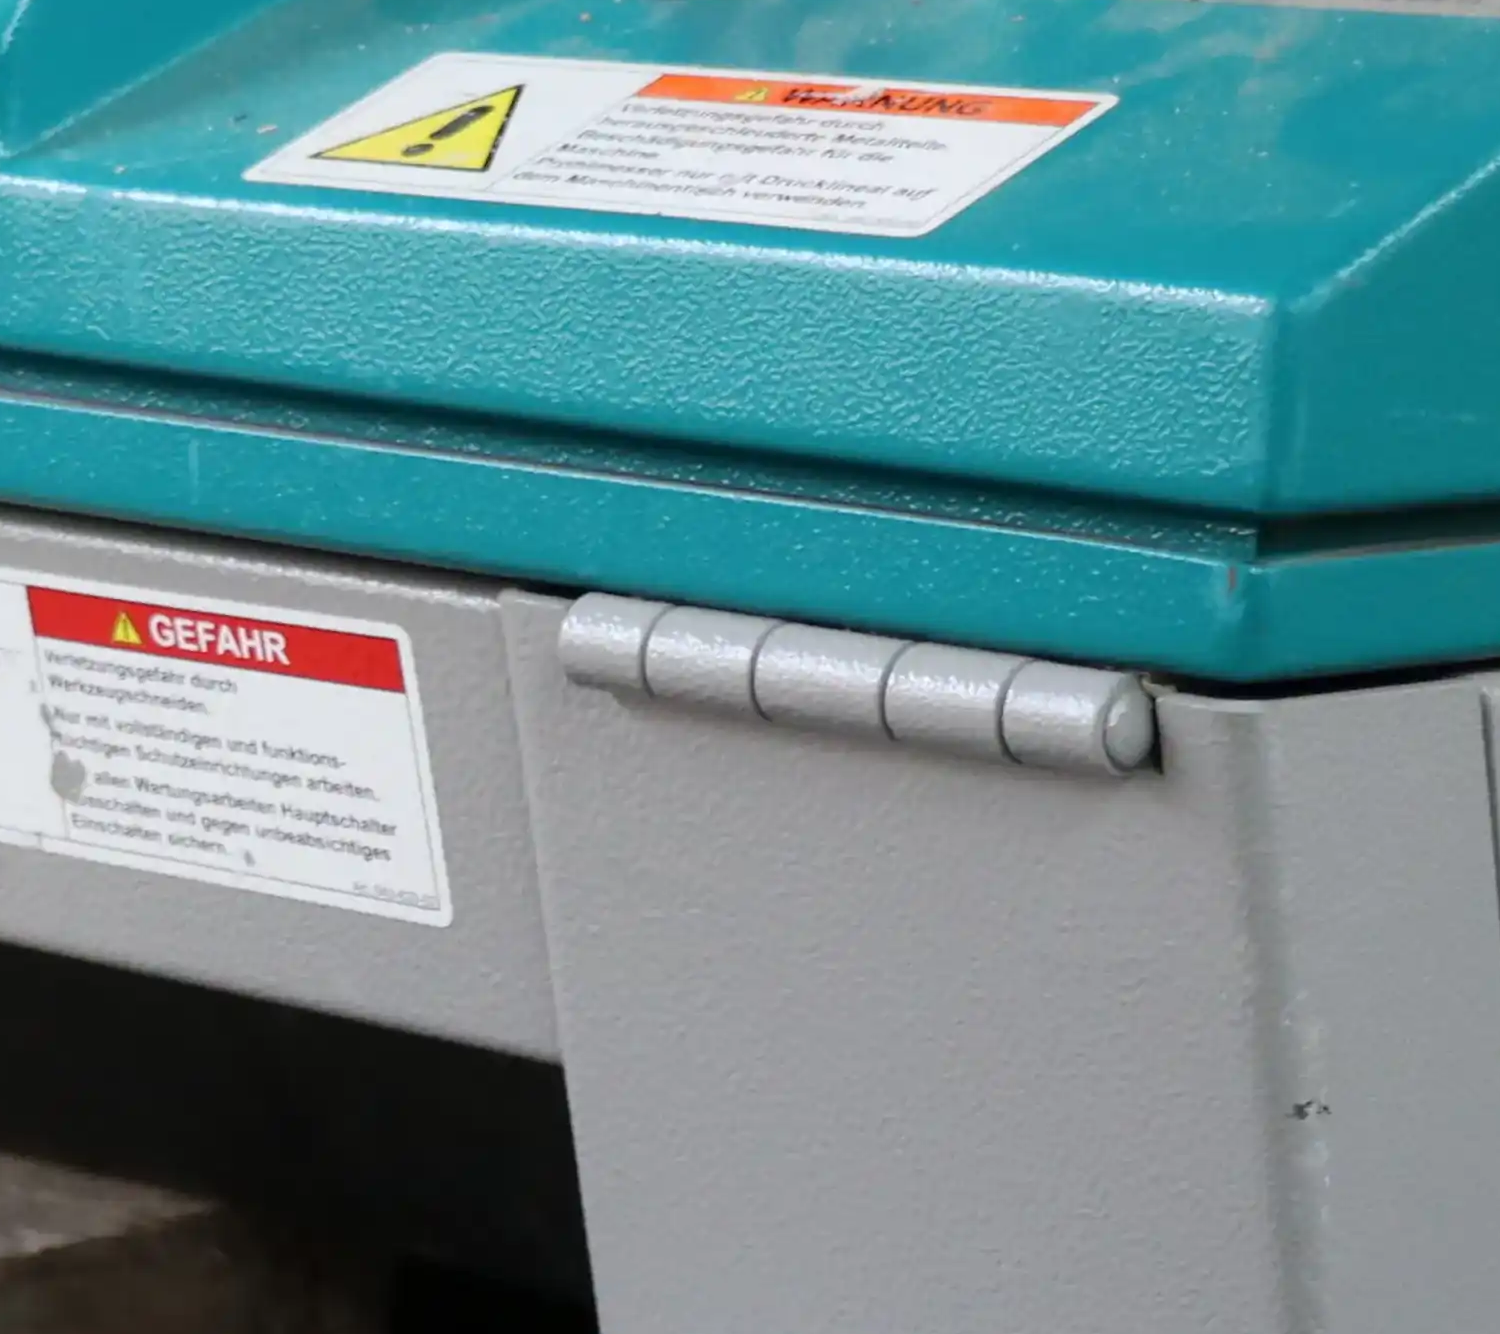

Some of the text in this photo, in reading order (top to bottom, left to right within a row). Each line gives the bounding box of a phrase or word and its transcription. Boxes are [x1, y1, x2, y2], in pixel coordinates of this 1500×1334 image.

[783, 87, 993, 116] WNUNG
[148, 613, 291, 666] GEFAHR
[190, 674, 238, 695] durch
[84, 715, 111, 730] mit
[226, 738, 258, 756] und
[74, 795, 162, 819] usschalten
[165, 809, 197, 826] und
[200, 815, 251, 837] gegen
[279, 802, 398, 837] Hauptschalter
